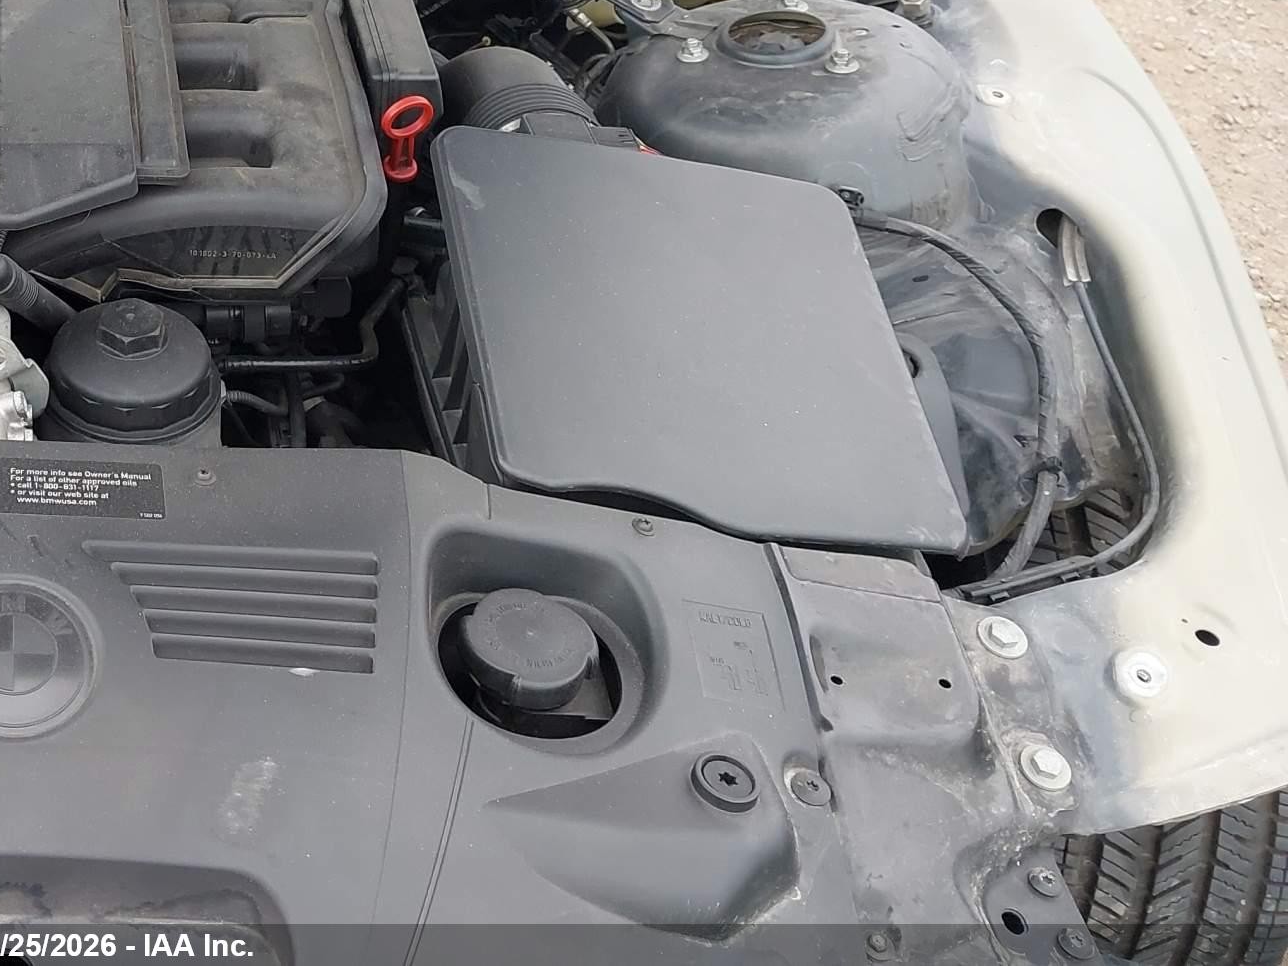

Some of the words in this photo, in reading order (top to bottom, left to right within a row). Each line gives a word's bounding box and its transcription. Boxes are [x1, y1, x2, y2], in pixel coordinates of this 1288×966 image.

[84, 470, 120, 479] Owner's
[120, 472, 152, 480] Manual
[82, 478, 121, 487] approved
[17, 497, 97, 506] www.bmwusa.com
